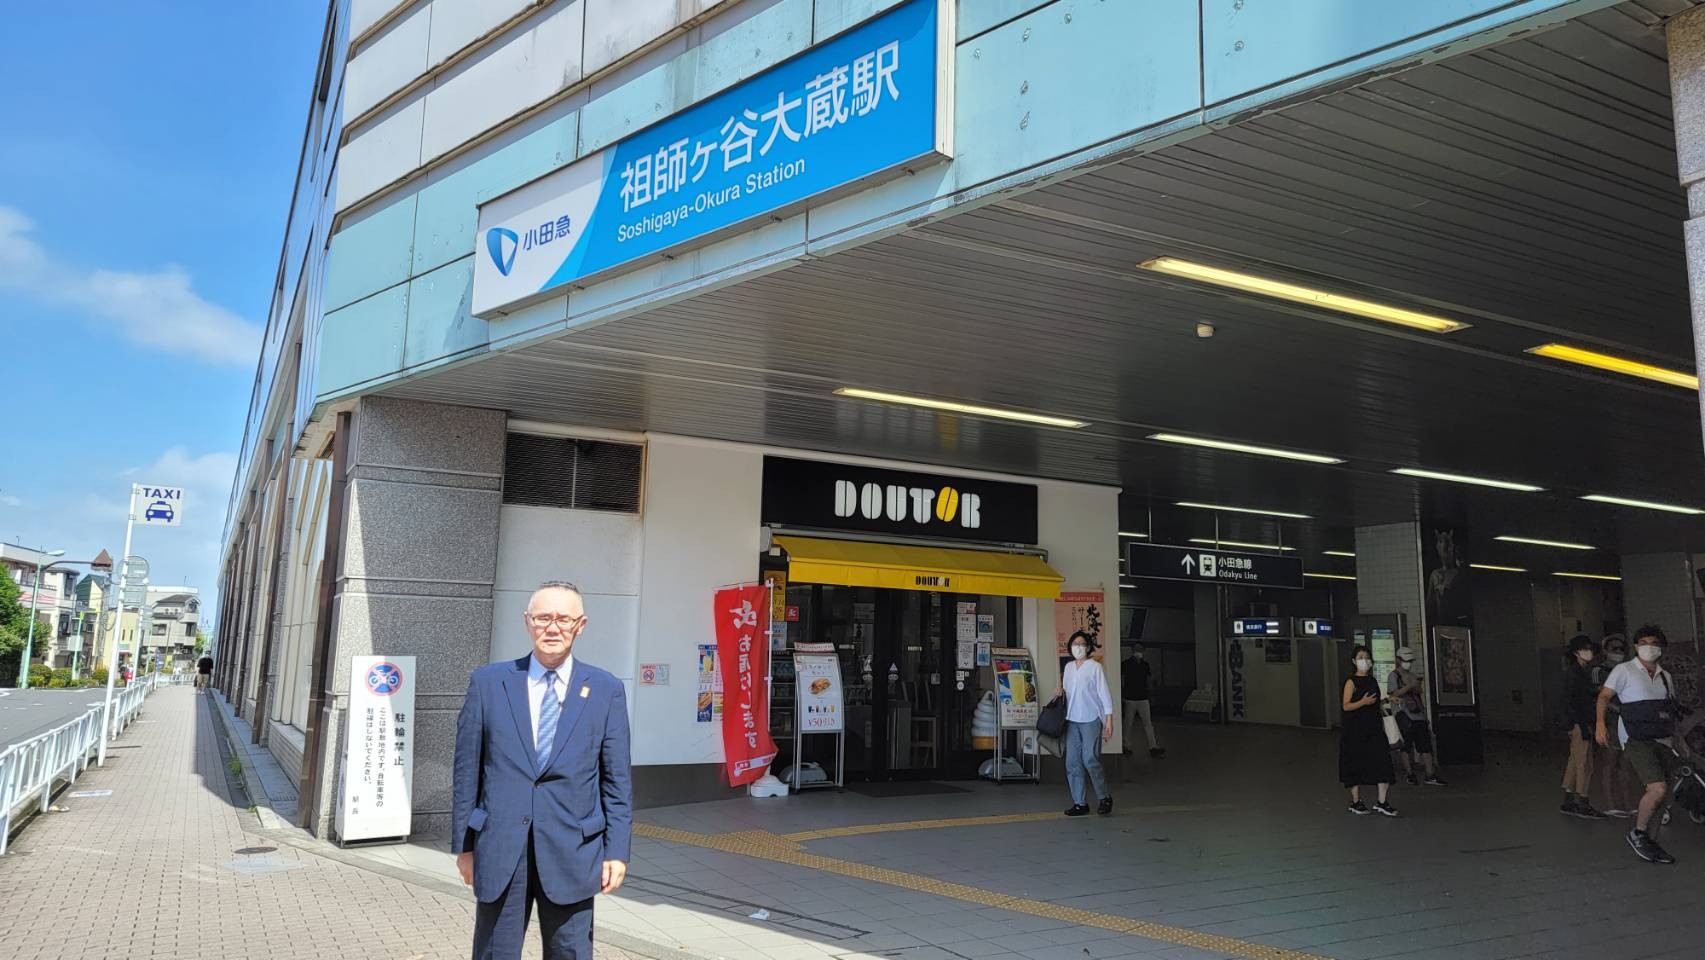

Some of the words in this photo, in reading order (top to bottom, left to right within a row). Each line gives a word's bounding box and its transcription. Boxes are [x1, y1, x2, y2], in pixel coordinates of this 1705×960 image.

[619, 39, 900, 213] 祖師ヶ谷大蔵駅
[617, 183, 741, 243] Soshigaya-Okura
[745, 158, 806, 194] Station
[522, 214, 572, 251] 小田急
[143, 488, 181, 500] TAXI
[834, 479, 981, 529] DOUTOR
[1218, 556, 1253, 570] 小田急線
[1218, 569, 1243, 581] Odakyu
[1244, 571, 1258, 581] Line
[393, 712, 406, 766] 駐輪禁止
